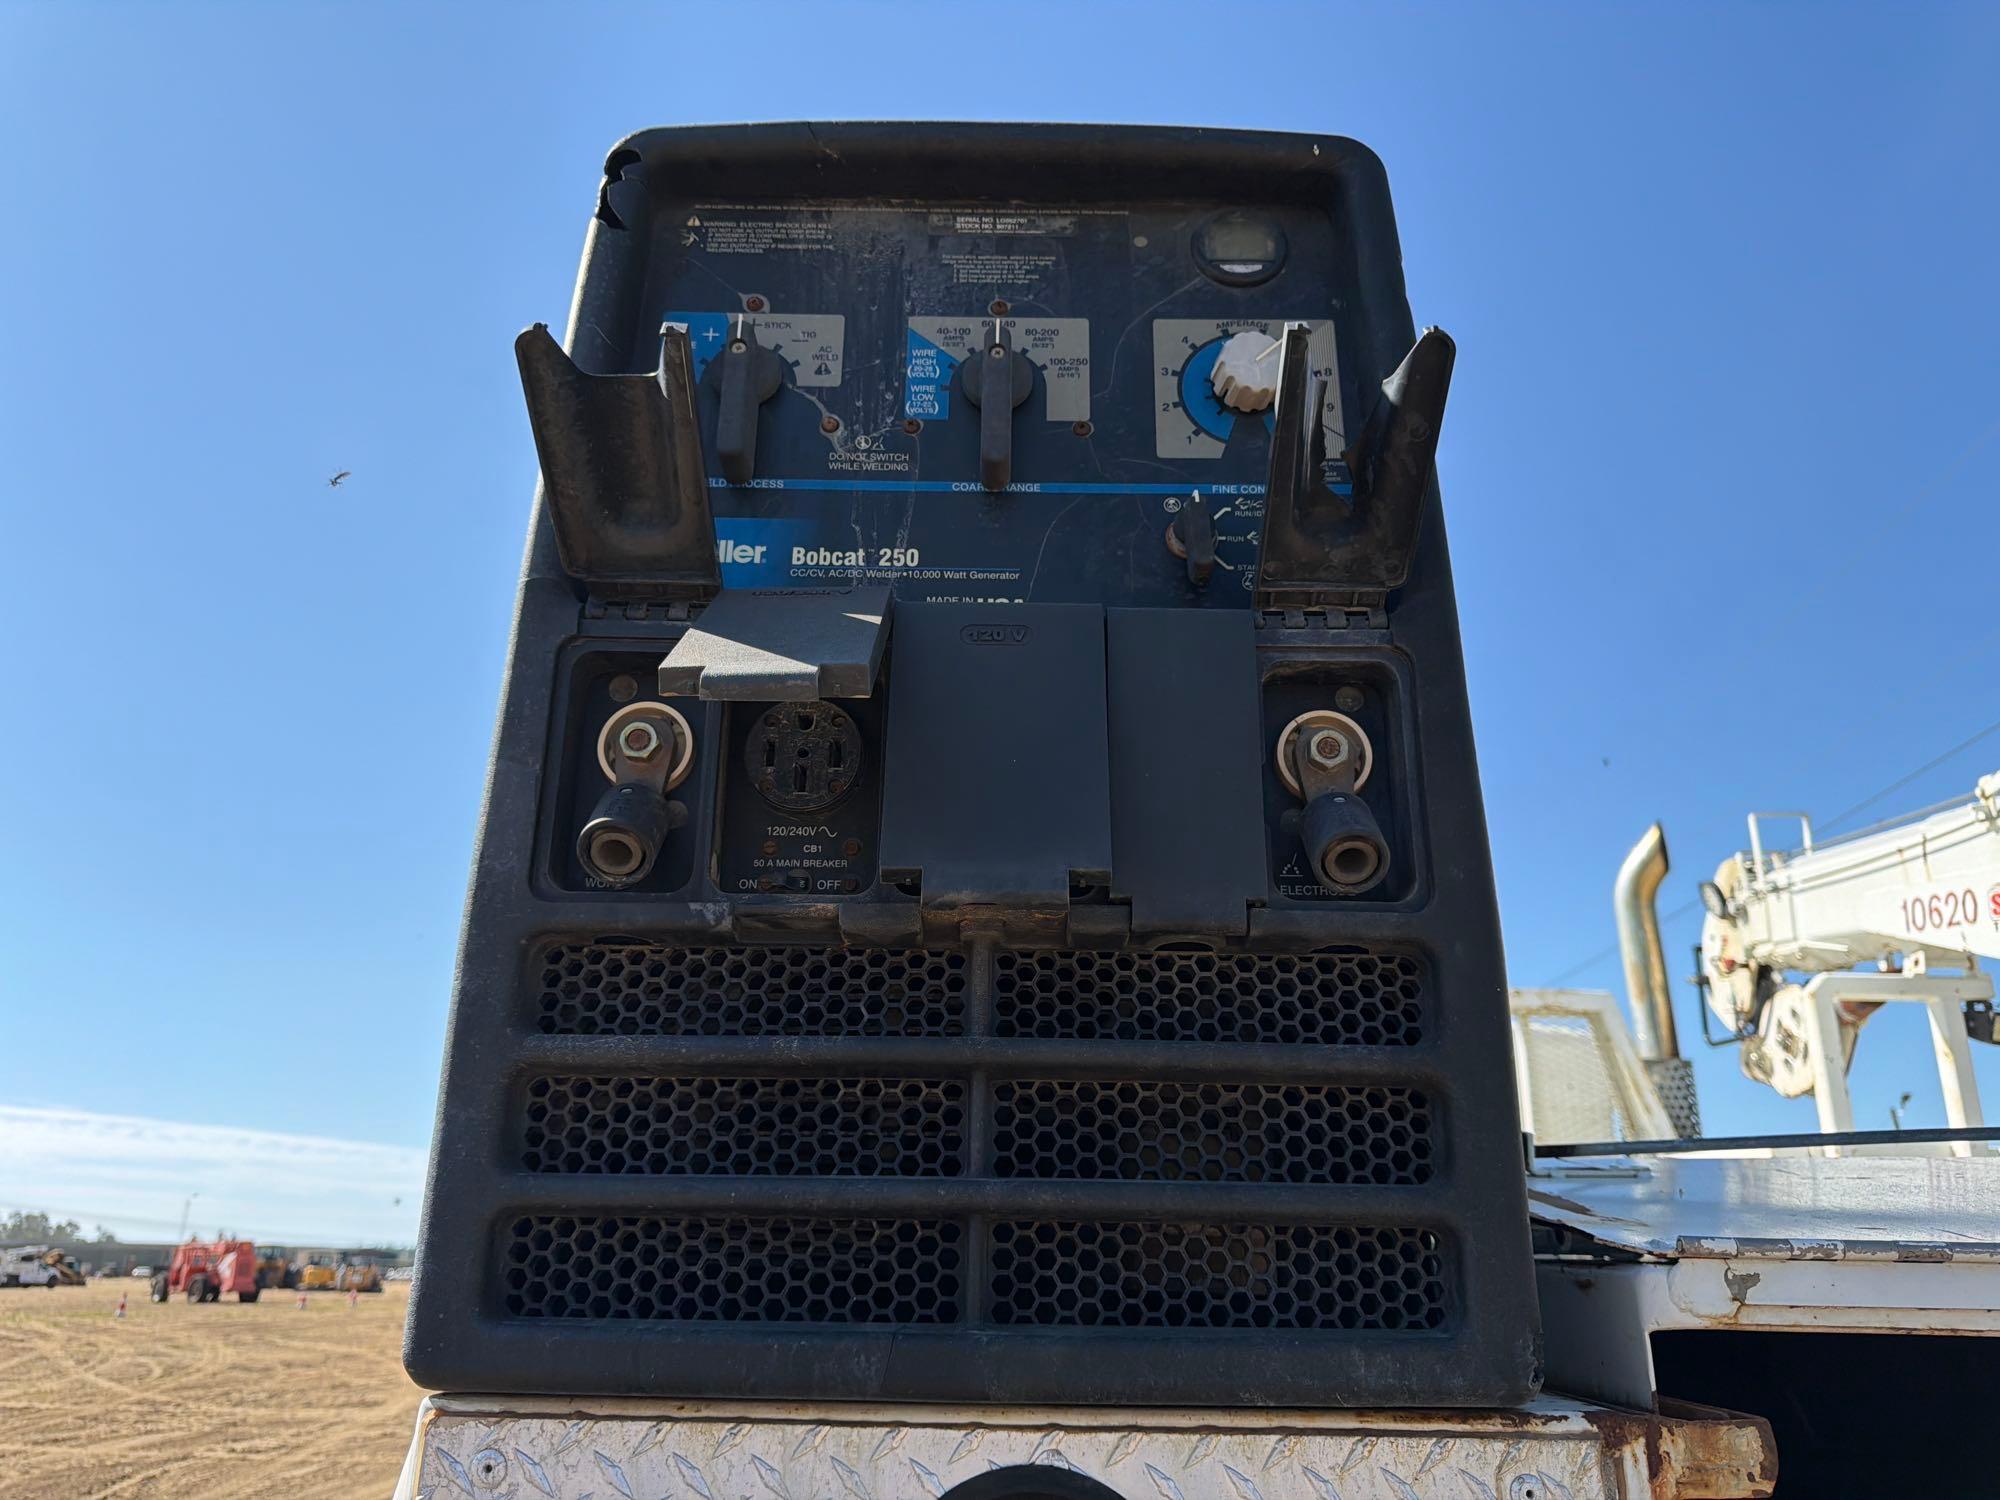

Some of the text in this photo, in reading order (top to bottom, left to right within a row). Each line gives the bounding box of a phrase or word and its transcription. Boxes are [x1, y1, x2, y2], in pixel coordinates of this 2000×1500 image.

[956, 216, 981, 224] SERIAL
[763, 321, 792, 329] STICK
[1216, 320, 1270, 331] AMPERAGE
[800, 330, 817, 339] TIG
[936, 327, 971, 336] 40-100
[1024, 328, 1060, 337] 80-200
[1180, 335, 1190, 345] 4
[818, 345, 832, 354] AC
[911, 348, 937, 357] WIRE
[811, 353, 839, 361] WELD
[911, 358, 937, 366] HIGH
[1049, 357, 1089, 366] 100-250
[1161, 367, 1169, 377] 3
[1323, 366, 1332, 377] 8
[910, 384, 937, 393] WIRE
[911, 393, 935, 402] LOW
[1162, 403, 1170, 412] 2
[1326, 402, 1335, 413] 9
[1185, 435, 1192, 445] 1
[829, 452, 910, 462] DO NOT SWITCH
[828, 462, 909, 472] WHILE WELDING
[1211, 484, 1238, 494] FINE
[791, 546, 920, 567] Bobcat 250
[789, 568, 827, 579] CC/CV,
[828, 568, 864, 578] AC/DC
[943, 570, 968, 580] Watt
[969, 571, 1021, 581] Generator
[1010, 629, 1026, 642] V
[767, 826, 817, 837] 120/240V
[803, 844, 822, 853] CB1
[753, 859, 848, 868] 50 A MAIN BREAKER
[738, 879, 758, 889] ON
[816, 879, 842, 890] OFF
[1902, 888, 1978, 934] 10620
